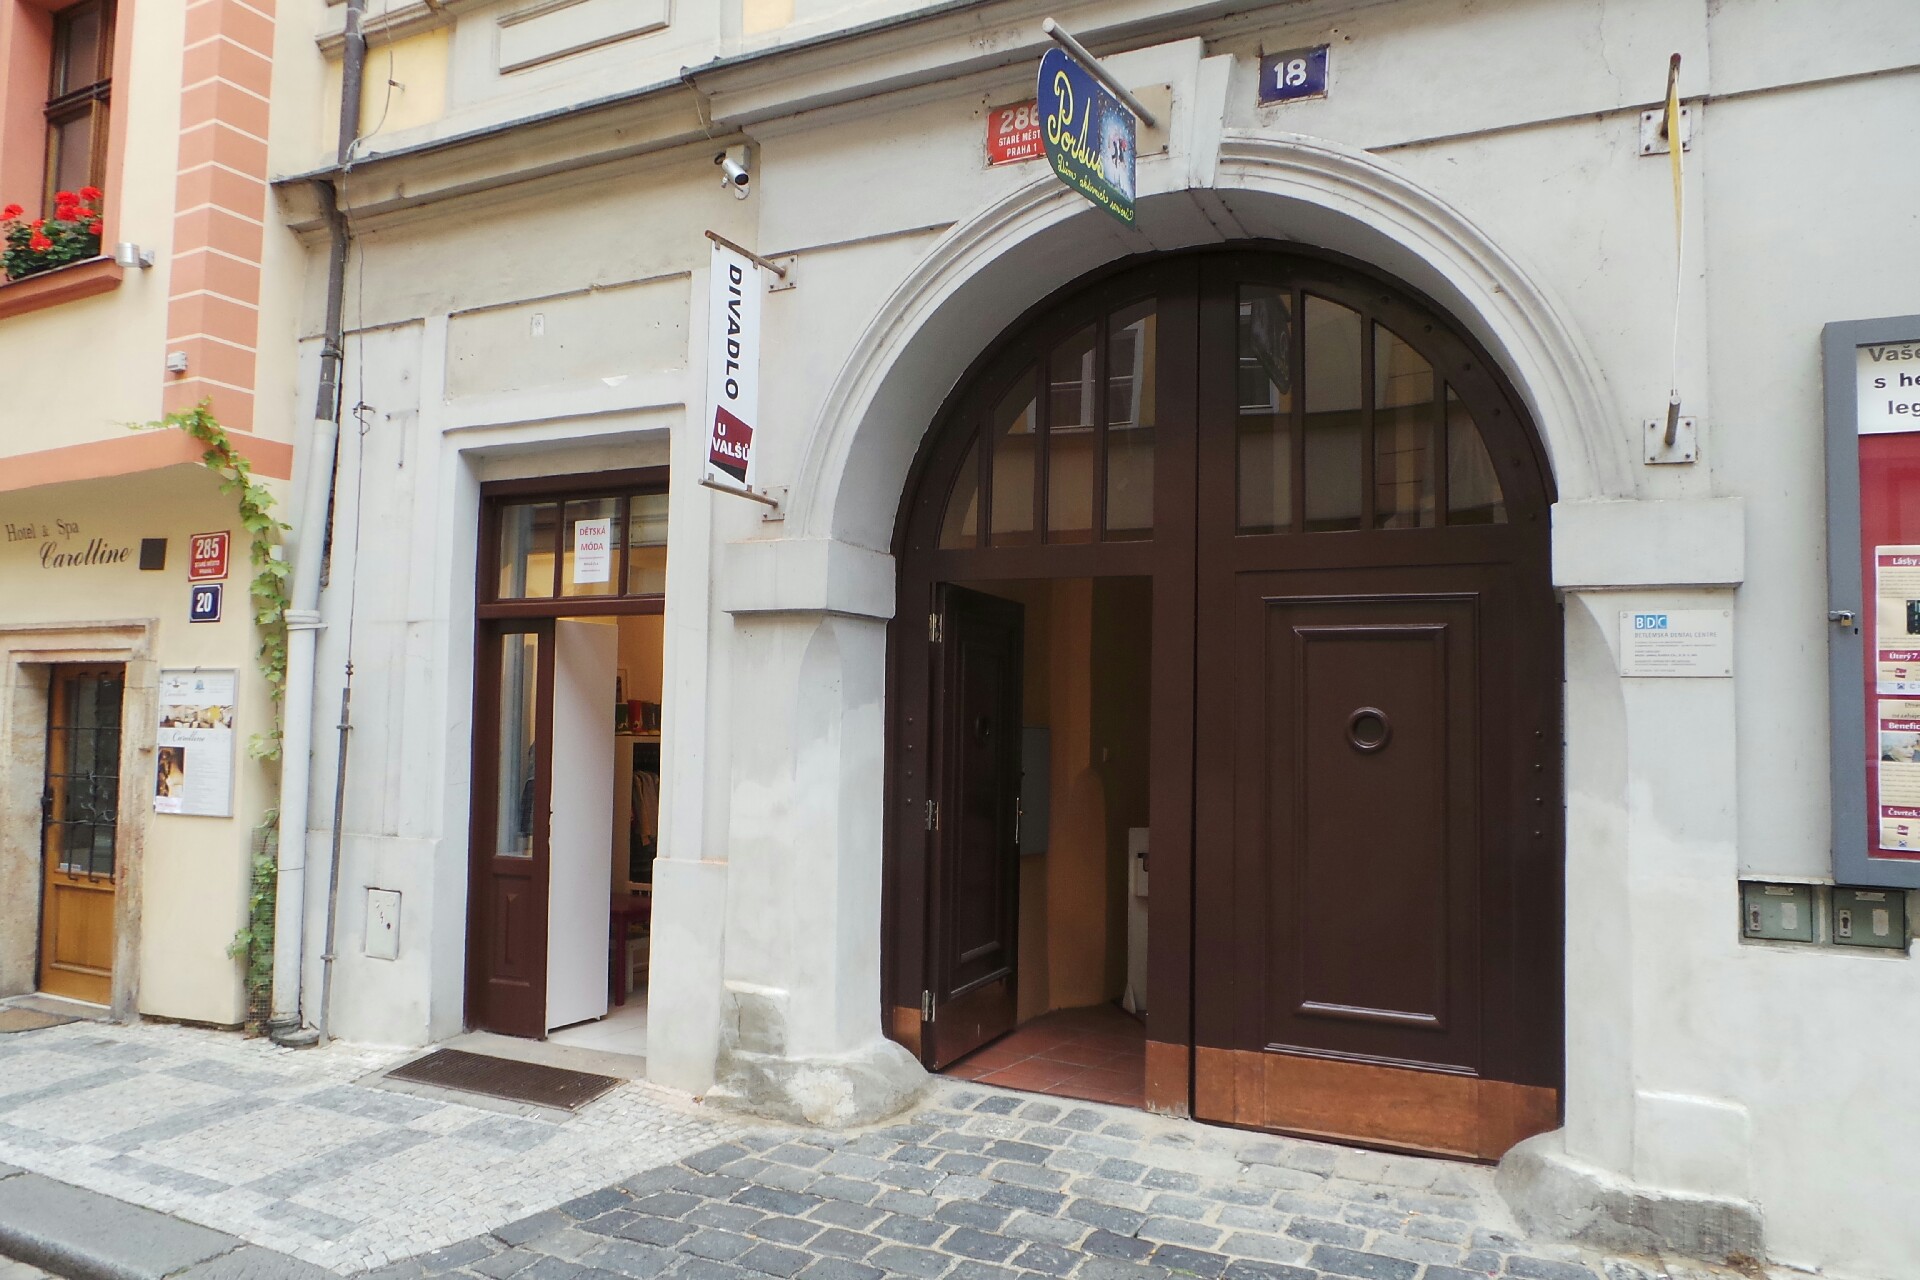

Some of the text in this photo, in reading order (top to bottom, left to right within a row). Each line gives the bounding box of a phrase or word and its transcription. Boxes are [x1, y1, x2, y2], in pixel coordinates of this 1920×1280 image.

[1274, 59, 1307, 89] 18
[1000, 104, 1040, 135] 286
[998, 132, 1020, 147] STARÉ
[1006, 142, 1038, 158] PRAHA 1
[725, 263, 742, 401] DIVADLO
[1874, 377, 1886, 389] s
[717, 422, 727, 437] U
[712, 436, 751, 462] VALŠŮ
[5, 518, 80, 542] Hotel & Spa
[579, 525, 606, 537] DĚTSKÁ
[40, 538, 132, 569] Carolline
[195, 537, 219, 560] 285
[580, 540, 604, 551] MÓDA
[196, 592, 213, 613] 20
[1636, 616, 1667, 629] BDC
